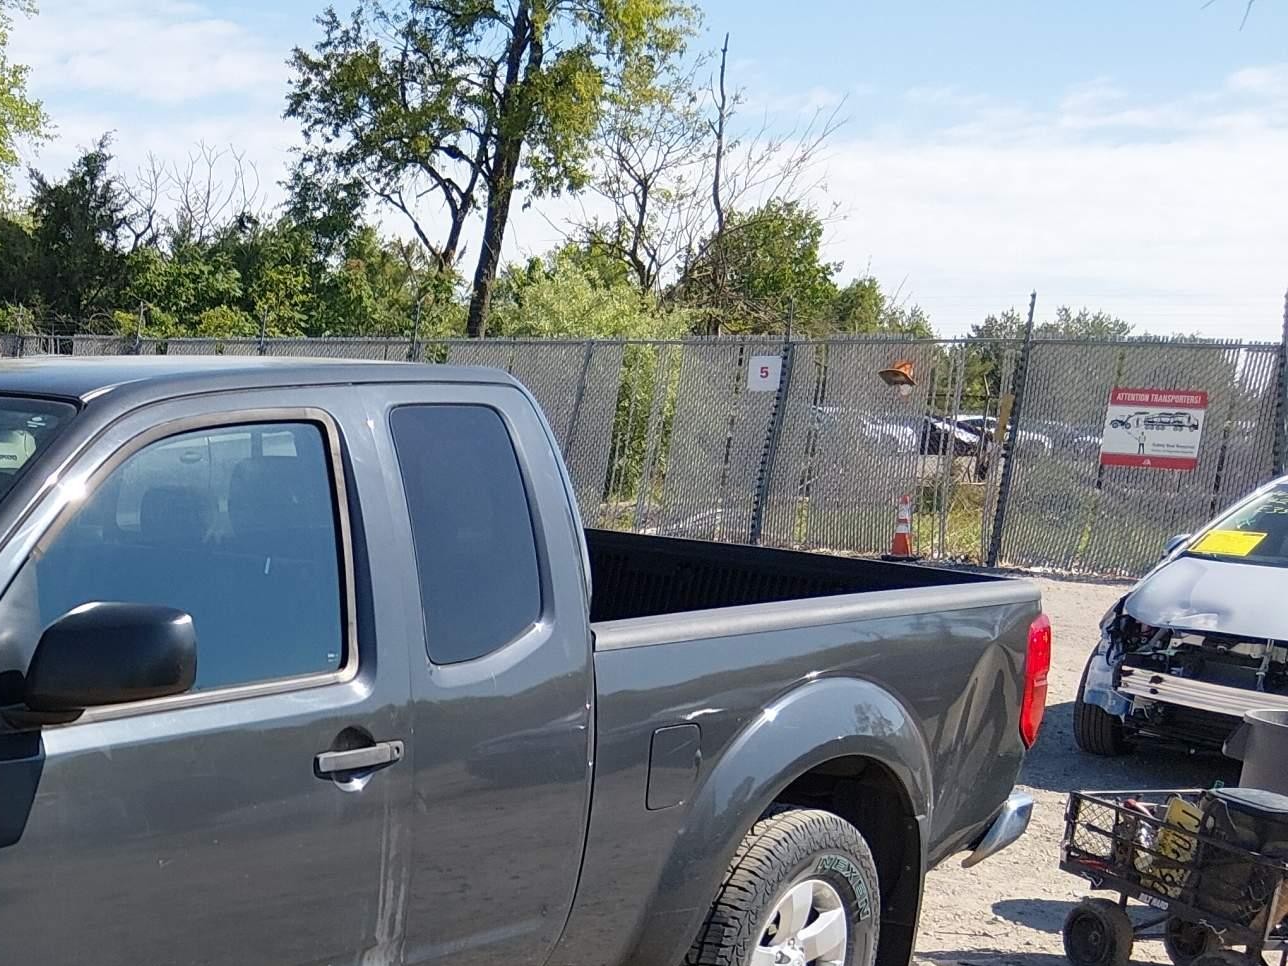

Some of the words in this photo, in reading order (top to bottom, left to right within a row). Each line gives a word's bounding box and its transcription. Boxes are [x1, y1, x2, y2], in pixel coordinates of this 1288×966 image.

[759, 366, 769, 379] 5
[1116, 392, 1149, 403] ATTENTION
[1151, 393, 1202, 405] TRANSPORTERS!
[816, 854, 871, 920] NEXEN
